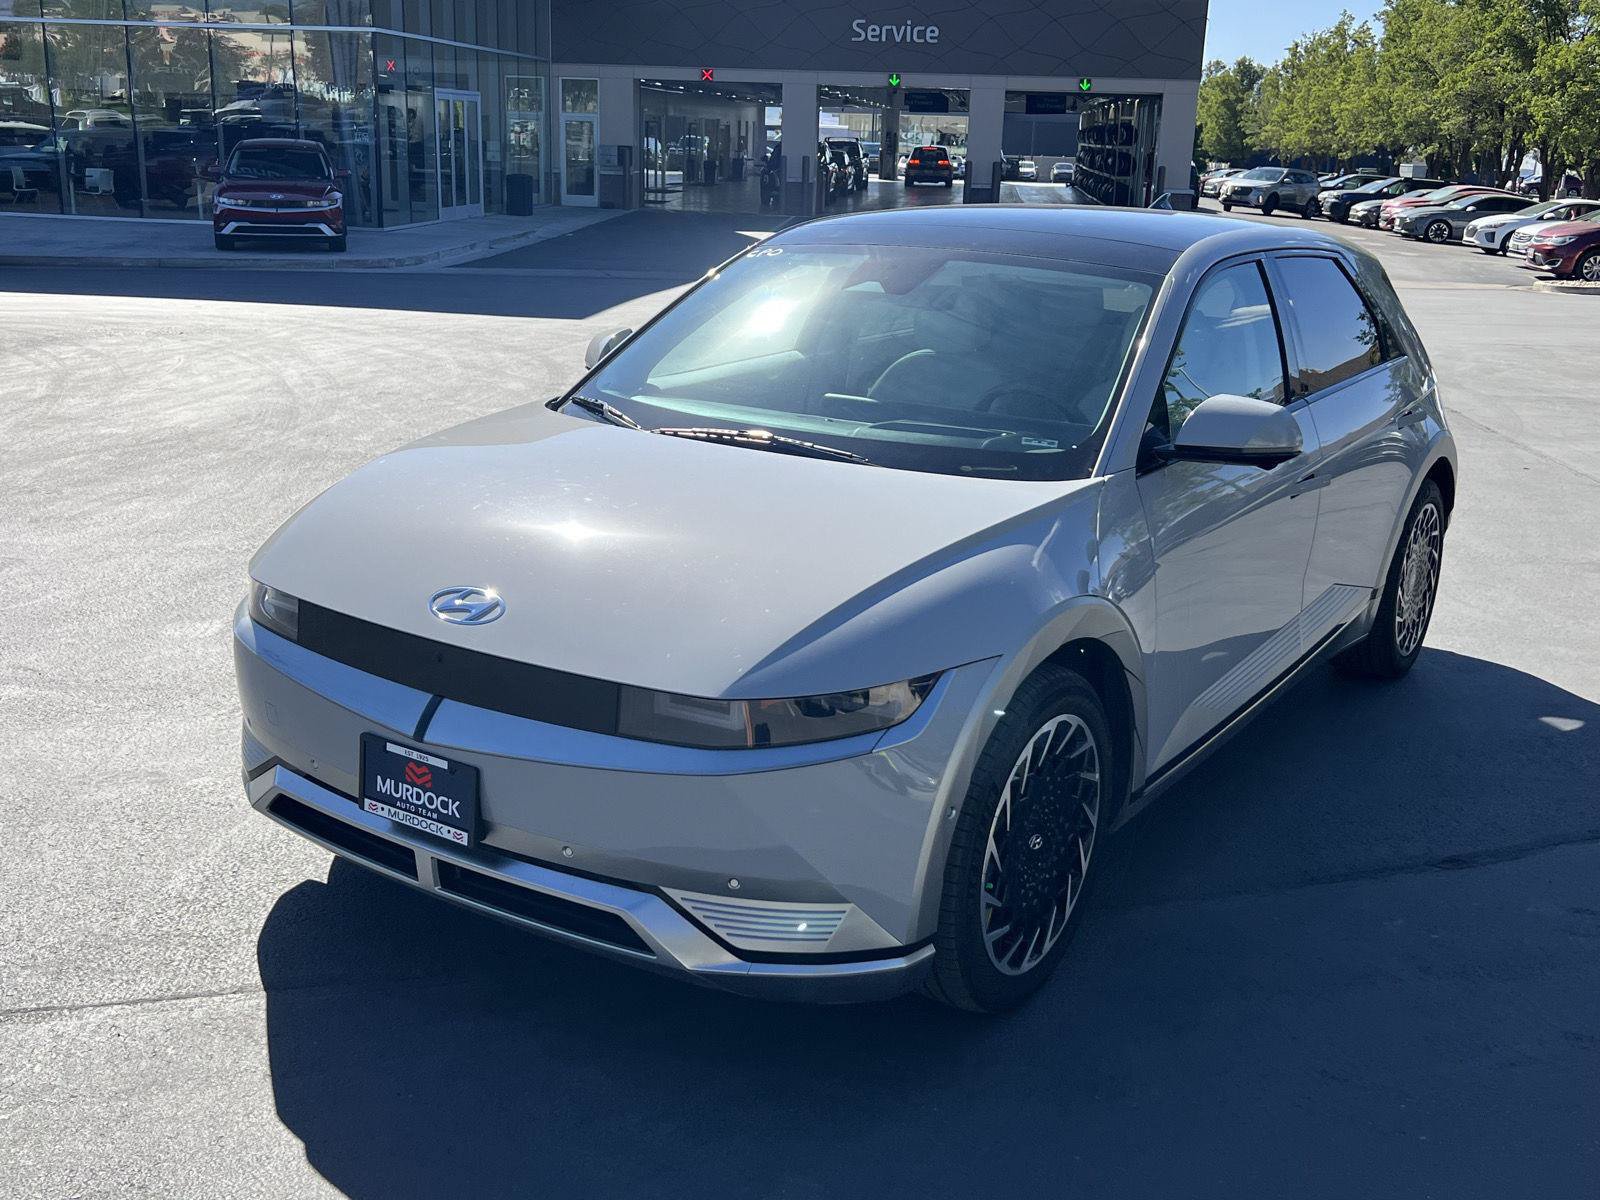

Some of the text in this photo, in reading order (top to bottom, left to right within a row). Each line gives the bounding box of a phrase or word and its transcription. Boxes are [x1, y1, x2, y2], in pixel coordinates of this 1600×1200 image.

[851, 19, 939, 43] Service
[416, 753, 429, 762] 1925
[376, 775, 461, 818] MURDOCK
[396, 800, 438, 819] AUTO TEAM
[387, 808, 444, 836] MURDOCK
